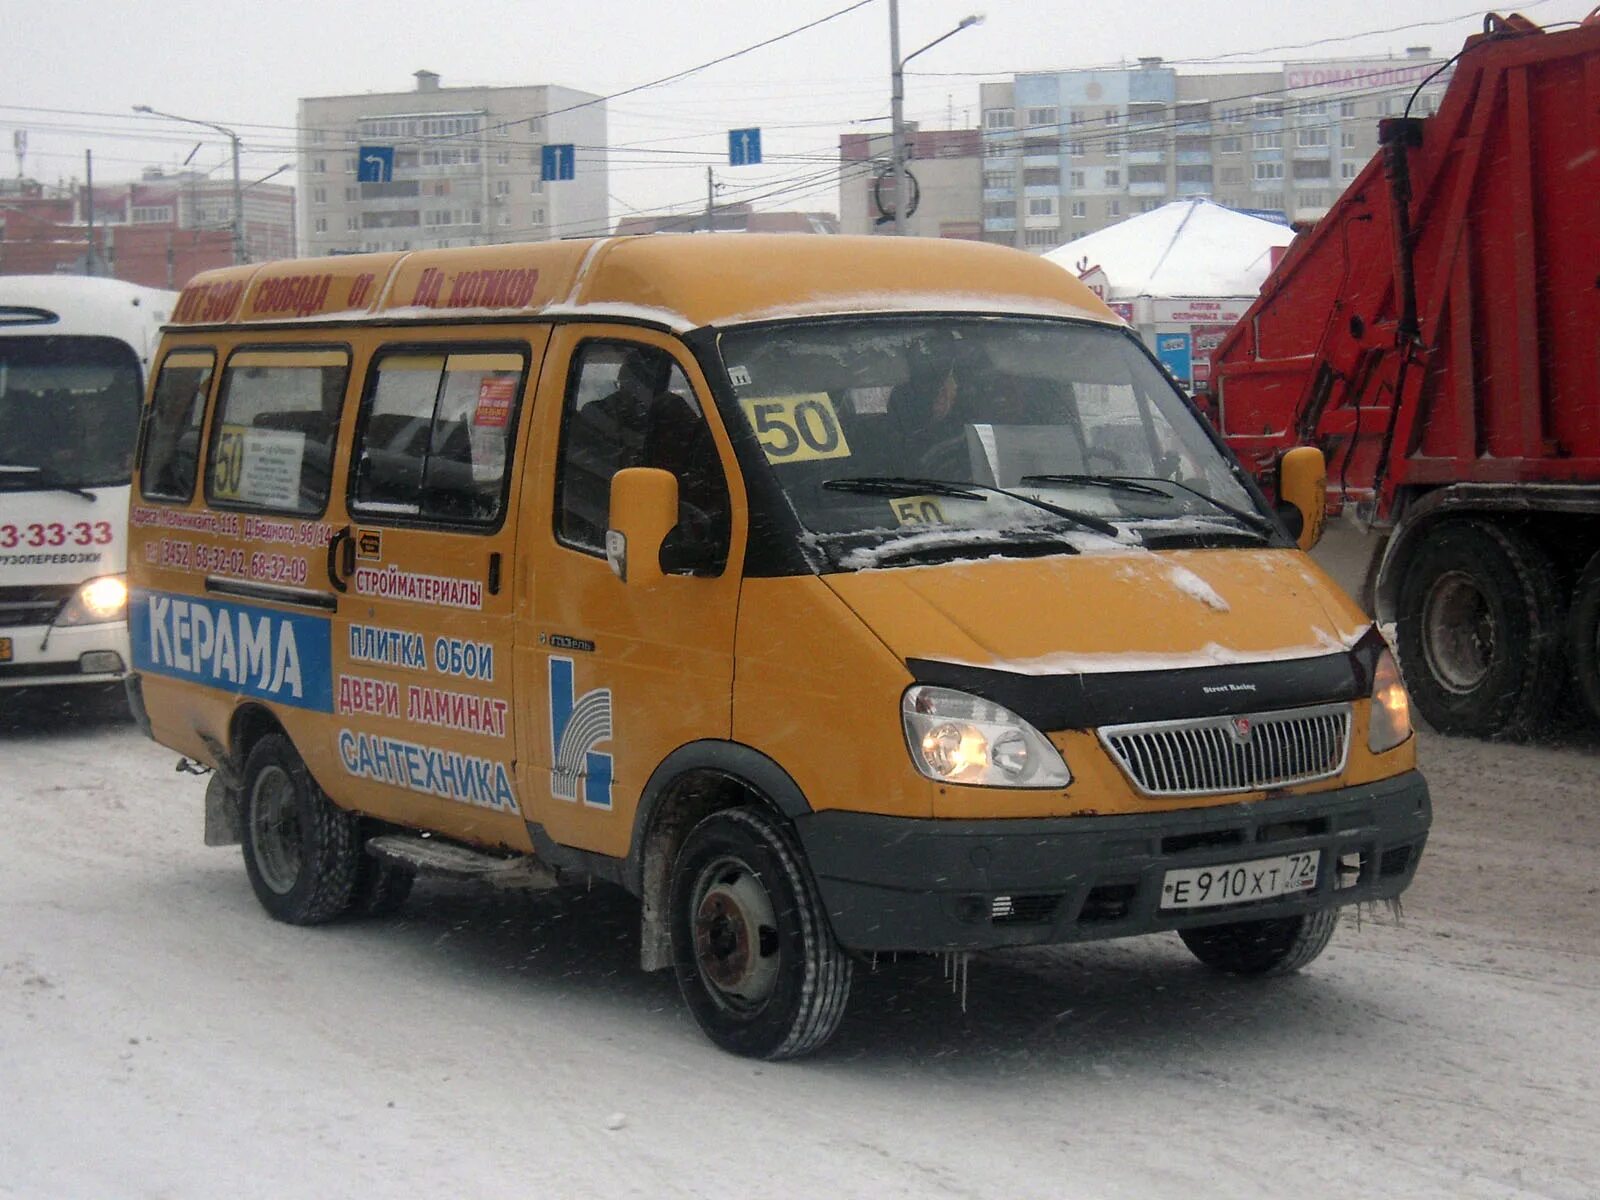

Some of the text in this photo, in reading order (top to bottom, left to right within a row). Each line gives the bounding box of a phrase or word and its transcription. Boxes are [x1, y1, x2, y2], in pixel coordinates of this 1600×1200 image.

[753, 401, 839, 457] 50
[216, 432, 244, 492] 50
[897, 501, 945, 525] 50
[251, 551, 308, 583] 68-32-09
[355, 566, 482, 607] СТРОЙМАТЕРИАЛЫ
[149, 595, 303, 699] КЕРАМА
[349, 625, 493, 680] ПЛИТКА ОБОИ
[338, 676, 508, 735] ДВЕРИ ЛАМИНАТ
[1202, 683, 1257, 694] Street Racing
[339, 731, 517, 810] САНТЕХНИКА
